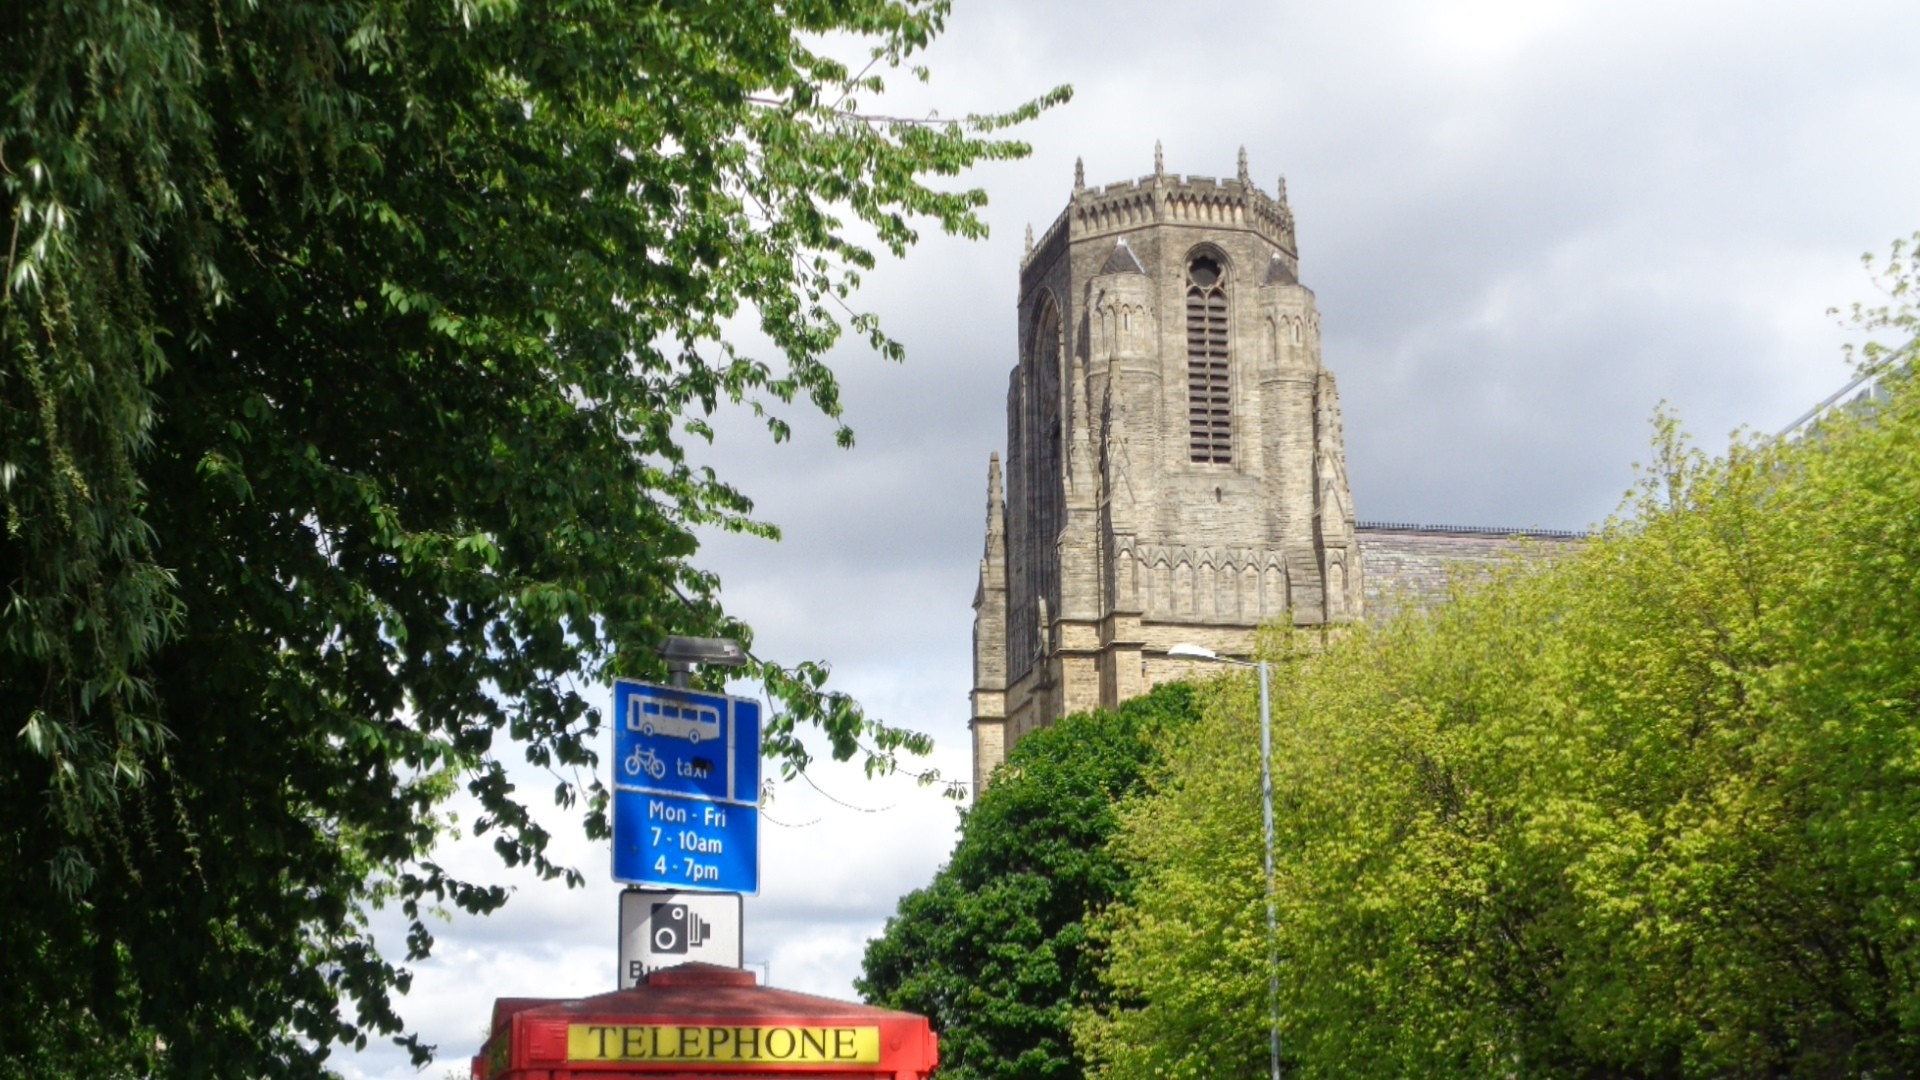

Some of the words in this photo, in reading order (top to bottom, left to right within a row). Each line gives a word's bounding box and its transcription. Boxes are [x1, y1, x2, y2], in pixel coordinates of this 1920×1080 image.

[649, 800, 686, 822] Mon
[704, 807, 726, 828] Fri
[651, 827, 662, 847] 7
[678, 831, 722, 854] 10am
[654, 855, 667, 875] 4
[684, 858, 718, 881] 7pm
[588, 1026, 858, 1060] TELEPHONE
